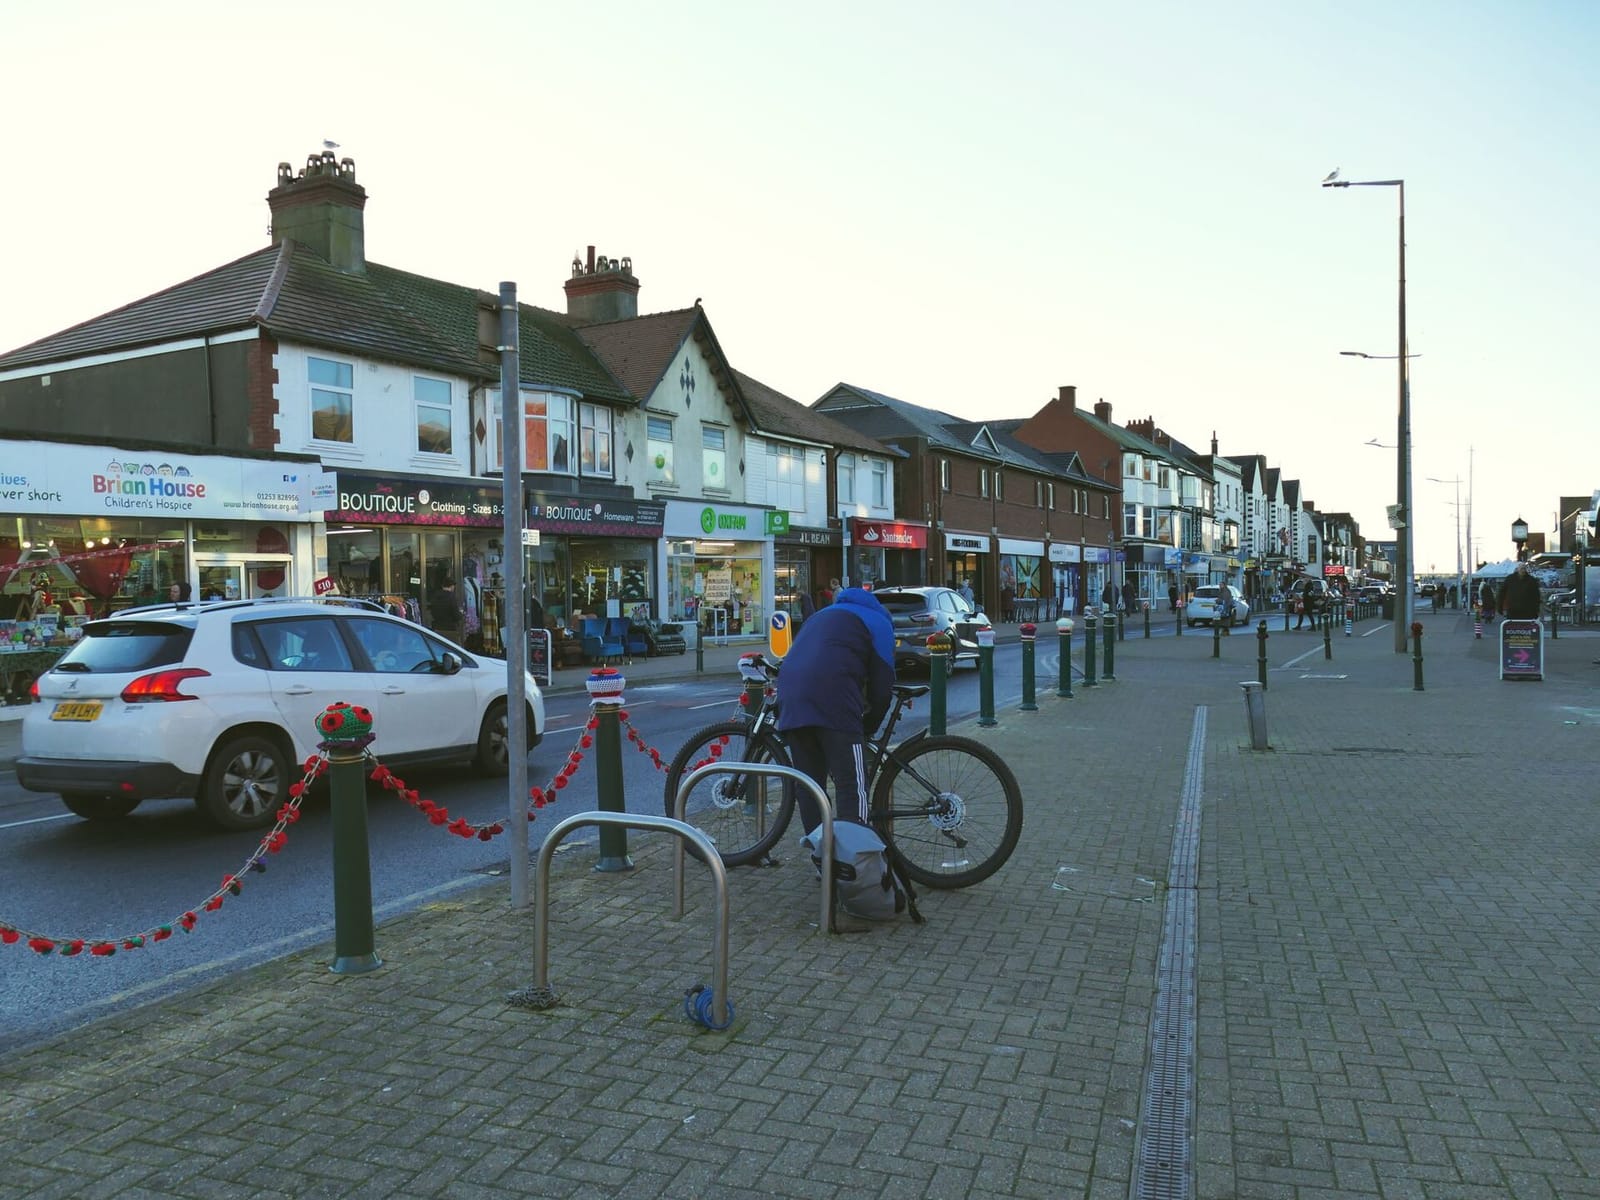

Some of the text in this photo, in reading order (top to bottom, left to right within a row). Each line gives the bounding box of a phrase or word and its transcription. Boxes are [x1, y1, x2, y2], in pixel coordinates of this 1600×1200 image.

[0, 473, 30, 487] ives,
[93, 474, 206, 498] Brian House
[28, 489, 62, 502] short
[256, 492, 276, 501] 01253
[340, 493, 415, 513] BOUTIQUE
[104, 496, 193, 511] Children's Hospice
[431, 501, 466, 515] Clothing
[472, 504, 492, 514] Sizes
[493, 505, 505, 515] 8-2
[546, 505, 592, 521] BOUTIQUE
[603, 512, 635, 522] Homeware
[718, 514, 747, 530] OXFAM
[881, 528, 913, 545] Santander
